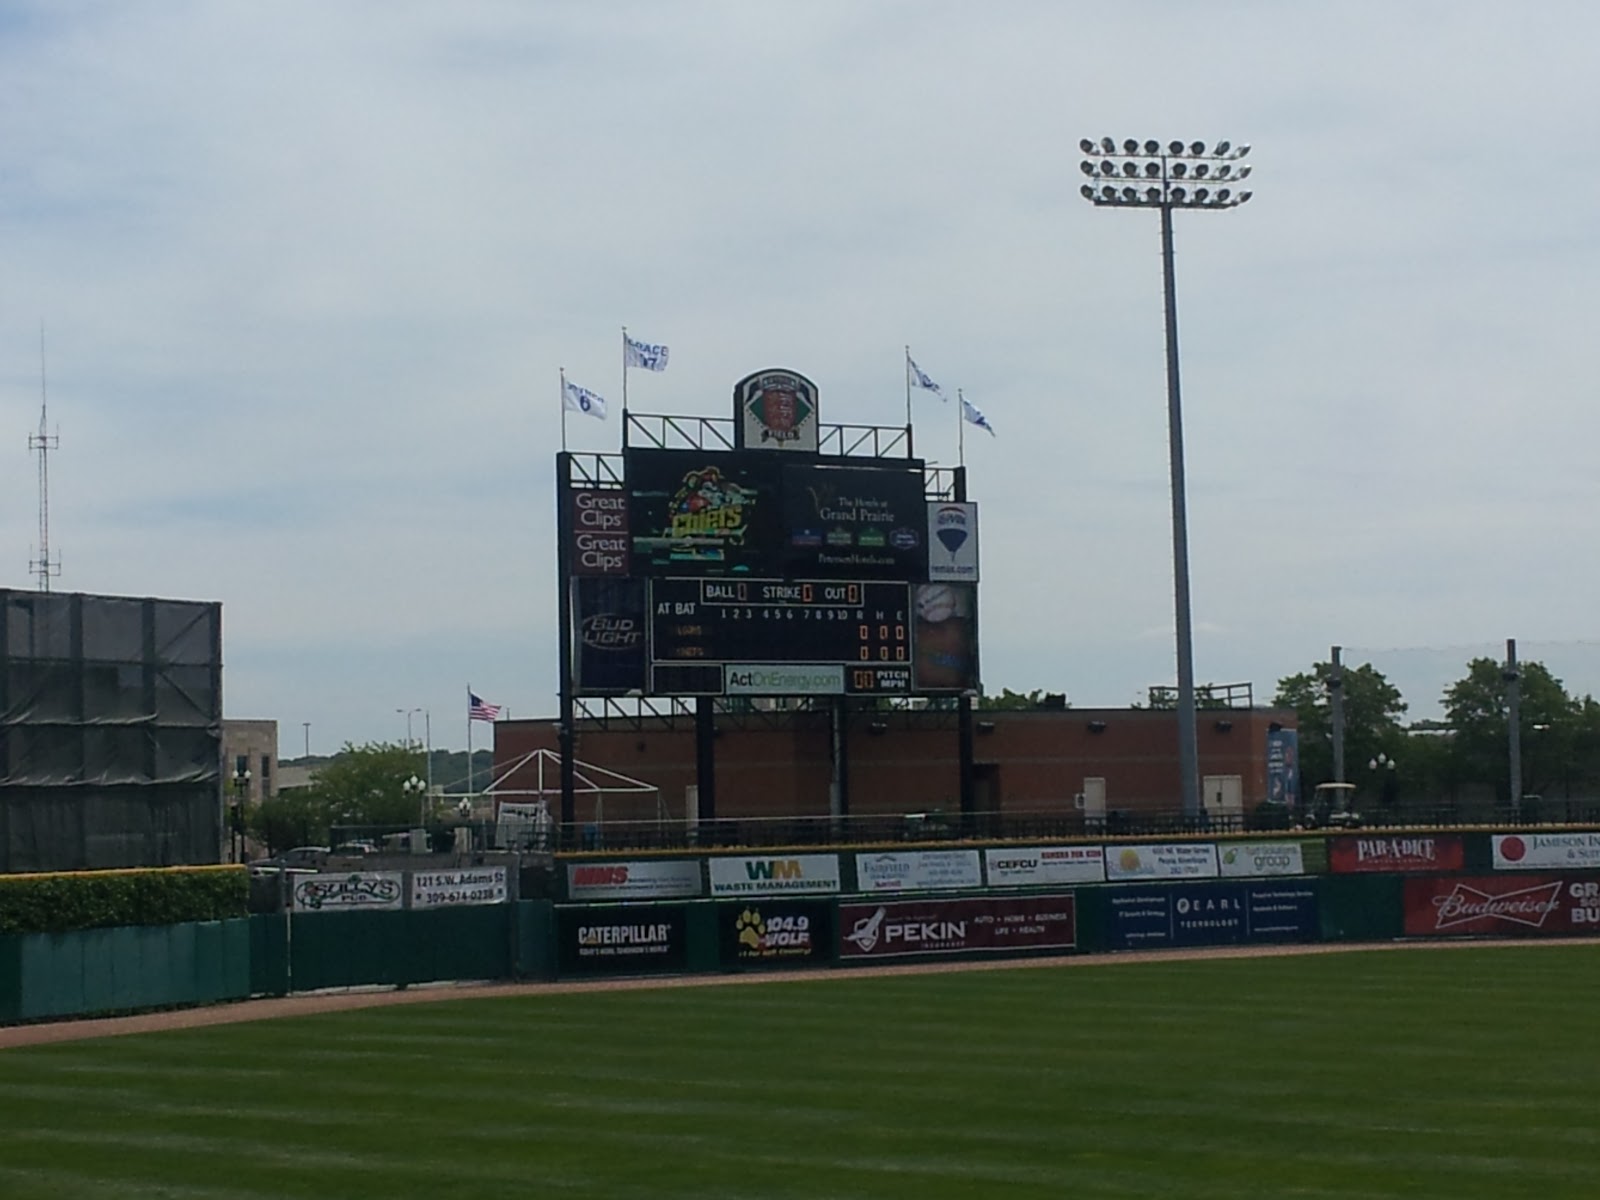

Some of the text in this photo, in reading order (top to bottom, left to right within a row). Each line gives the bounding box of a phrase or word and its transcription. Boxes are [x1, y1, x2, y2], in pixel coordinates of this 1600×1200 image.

[579, 395, 592, 412] 6
[576, 492, 625, 510] Great
[580, 510, 623, 529] Clips
[820, 507, 895, 522] Grand Prairie
[577, 534, 626, 552] Great
[581, 552, 624, 571] Clips
[706, 585, 735, 598] BALL
[763, 586, 801, 599] STRIKE
[825, 588, 846, 599] OUT
[657, 603, 696, 615] AT BAT
[721, 609, 726, 618] 1
[733, 609, 740, 618] 2
[746, 609, 752, 618] 3
[763, 609, 769, 618] 4
[774, 610, 781, 619] 5
[786, 610, 793, 619] 6
[804, 610, 810, 619] 7
[815, 610, 822, 619] 8
[827, 610, 834, 619] 9
[837, 610, 848, 620] 10
[876, 611, 884, 619] H
[896, 611, 903, 620] E
[591, 619, 634, 631] BUD
[584, 631, 641, 644] LIGHT
[730, 672, 841, 690] ActOnEnergy.com
[877, 670, 908, 679] PITCH
[881, 679, 905, 688] MPH
[1357, 838, 1436, 861] PAR-A-DICE
[1533, 836, 1585, 850] JAMESON
[746, 861, 801, 879] WM
[997, 859, 1037, 869] CEFCU
[1254, 855, 1290, 871] group
[416, 876, 433, 888] 121
[460, 873, 493, 885] Adams
[714, 879, 837, 892] WASTE MANAGEMENT
[1569, 882, 1600, 898] GR
[1432, 895, 1560, 918] Budweiser
[766, 917, 809, 932] 104.9
[974, 916, 994, 924] AUTO
[1004, 915, 1025, 923] HOME
[578, 925, 668, 944] CATERPILLAR
[885, 921, 966, 943] PEKIN
[995, 927, 1009, 935] LIFE
[765, 932, 810, 947] WOLF
